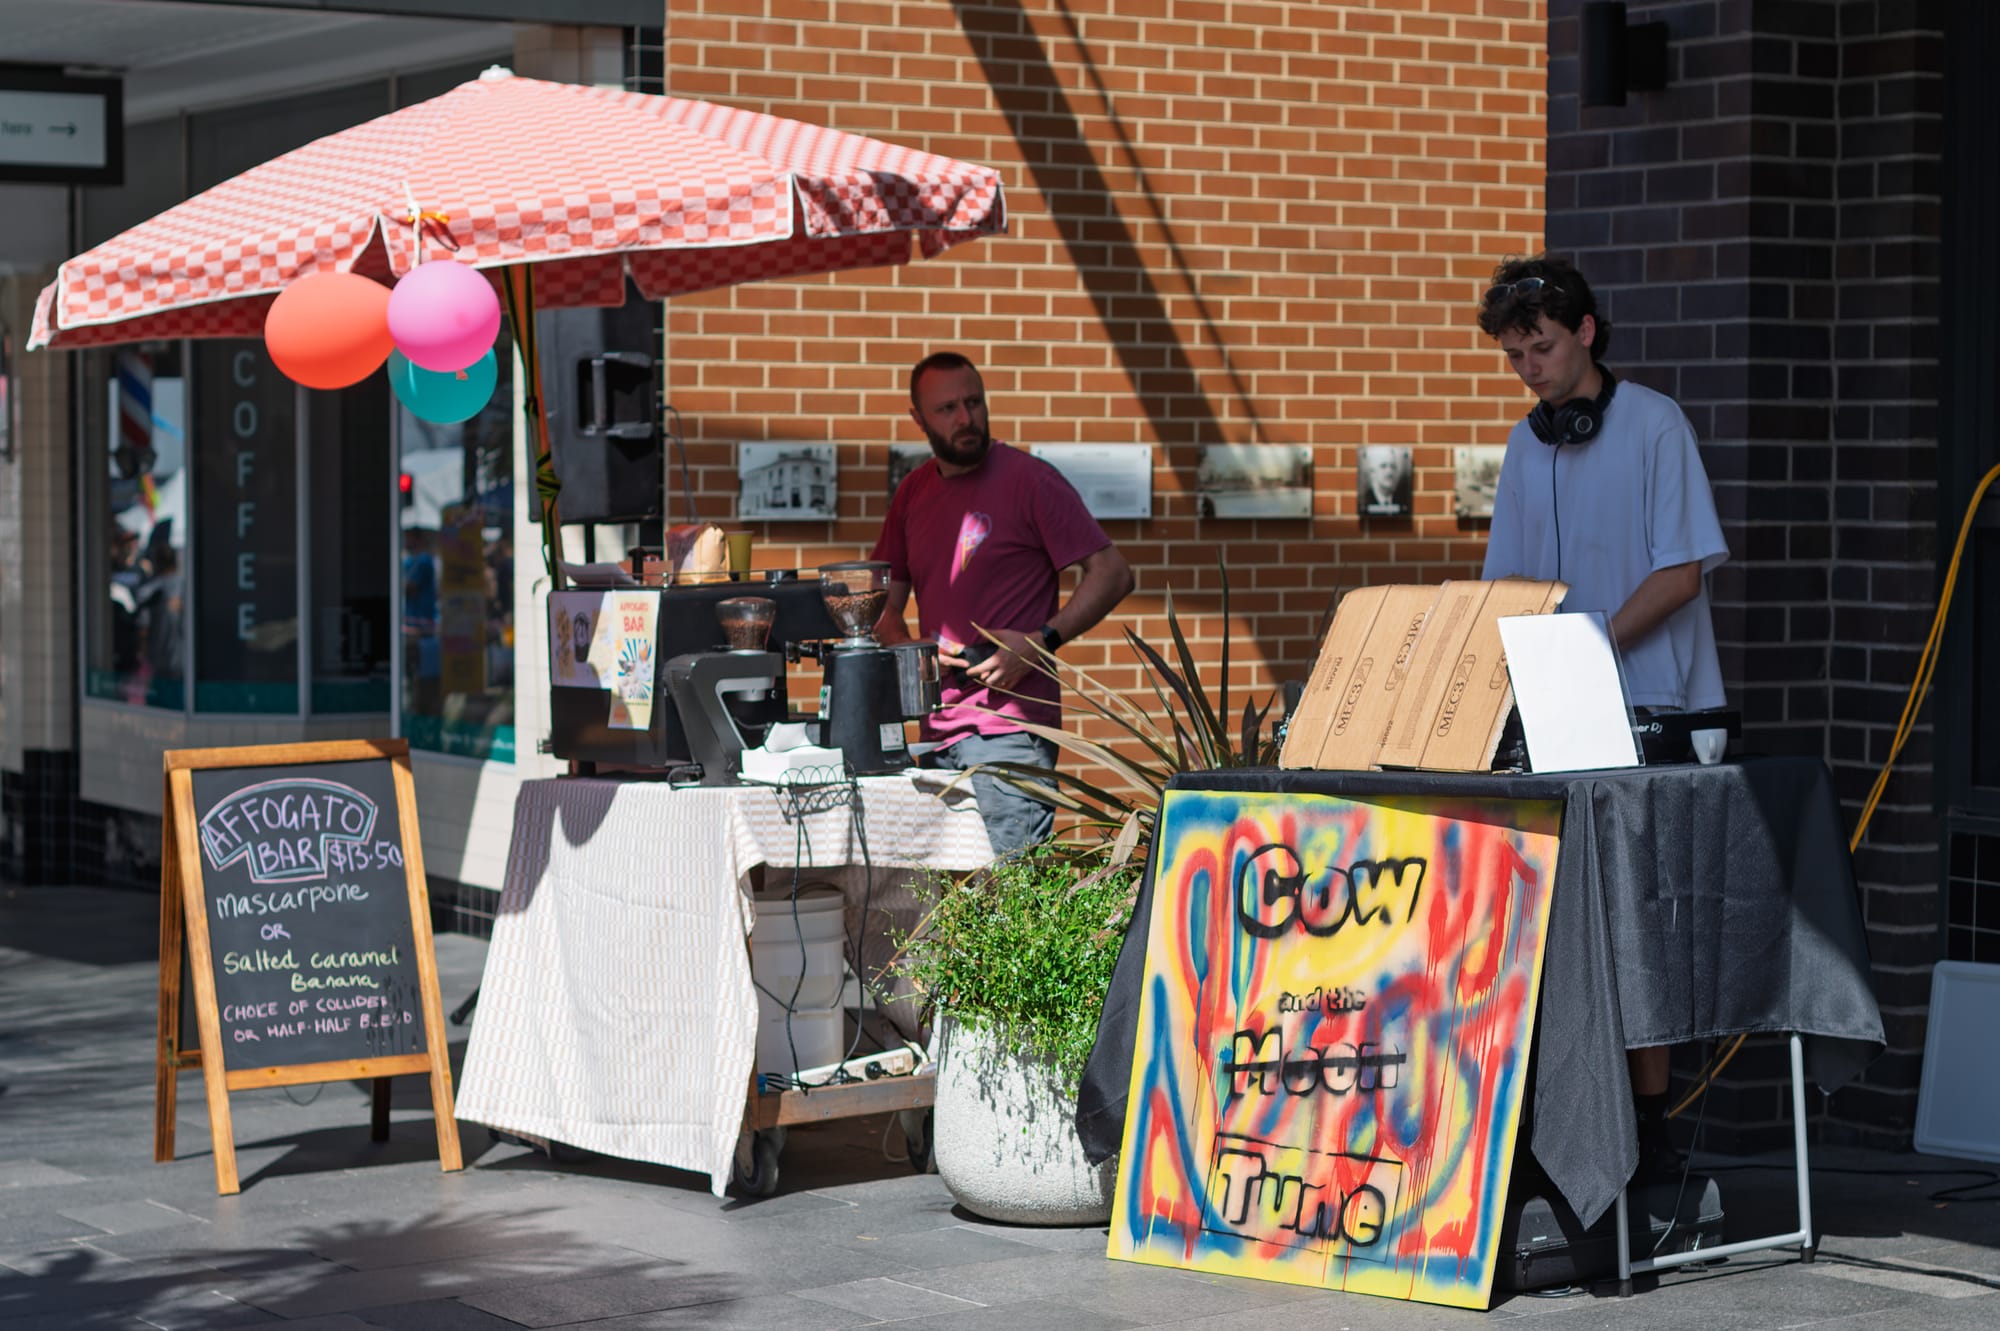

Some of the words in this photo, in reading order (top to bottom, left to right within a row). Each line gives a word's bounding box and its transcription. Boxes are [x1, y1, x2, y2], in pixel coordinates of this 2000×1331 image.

[233, 350, 257, 641] COFFEE
[623, 616, 645, 632] BAR
[1439, 681, 1465, 730] MEC3
[205, 794, 364, 858] AFFOGATO
[257, 837, 321, 873] BAR
[260, 923, 291, 940] OR
[223, 949, 300, 975] Salted
[291, 972, 380, 992] Banana
[223, 1002, 278, 1022] CHOICE
[288, 1000, 309, 1015] OF
[1278, 986, 1322, 1013] and
[1326, 985, 1366, 1013] the
[233, 1029, 260, 1043] OR
[359, 1010, 412, 1029] BED
[1216, 1148, 1386, 1247] Tune
